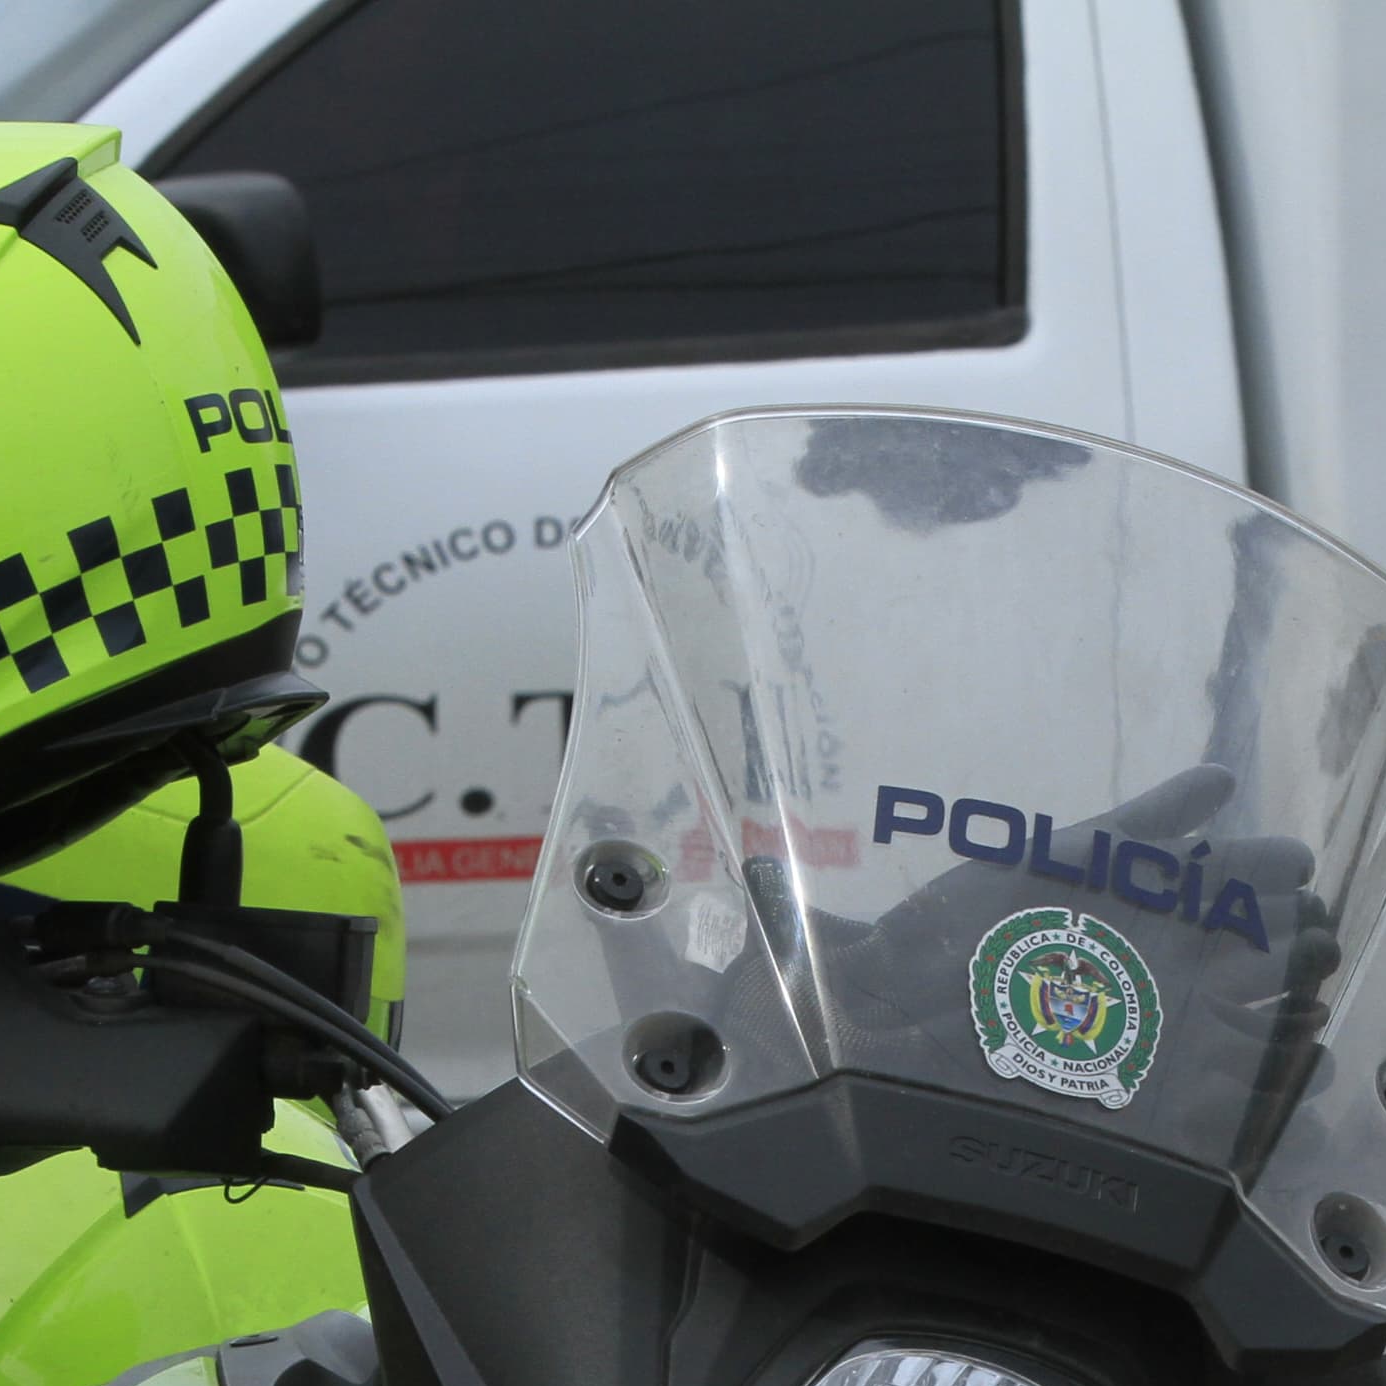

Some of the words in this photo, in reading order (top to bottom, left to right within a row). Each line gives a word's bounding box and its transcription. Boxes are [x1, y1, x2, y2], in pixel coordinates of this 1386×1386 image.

[319, 518, 517, 632] TÉCNICO
[873, 785, 1270, 953] POLICÍA
[997, 933, 1052, 995] REPUBLICA
[1066, 932, 1086, 947] DE
[1100, 951, 1139, 1030] COLOMBIA
[1012, 1052, 1045, 1079] DIOS
[1047, 1074, 1057, 1083] Y
[1061, 1077, 1110, 1092] PATRIA
[1063, 1045, 1130, 1073] NACIONAL
[948, 1136, 1139, 1214] SUZUKI
